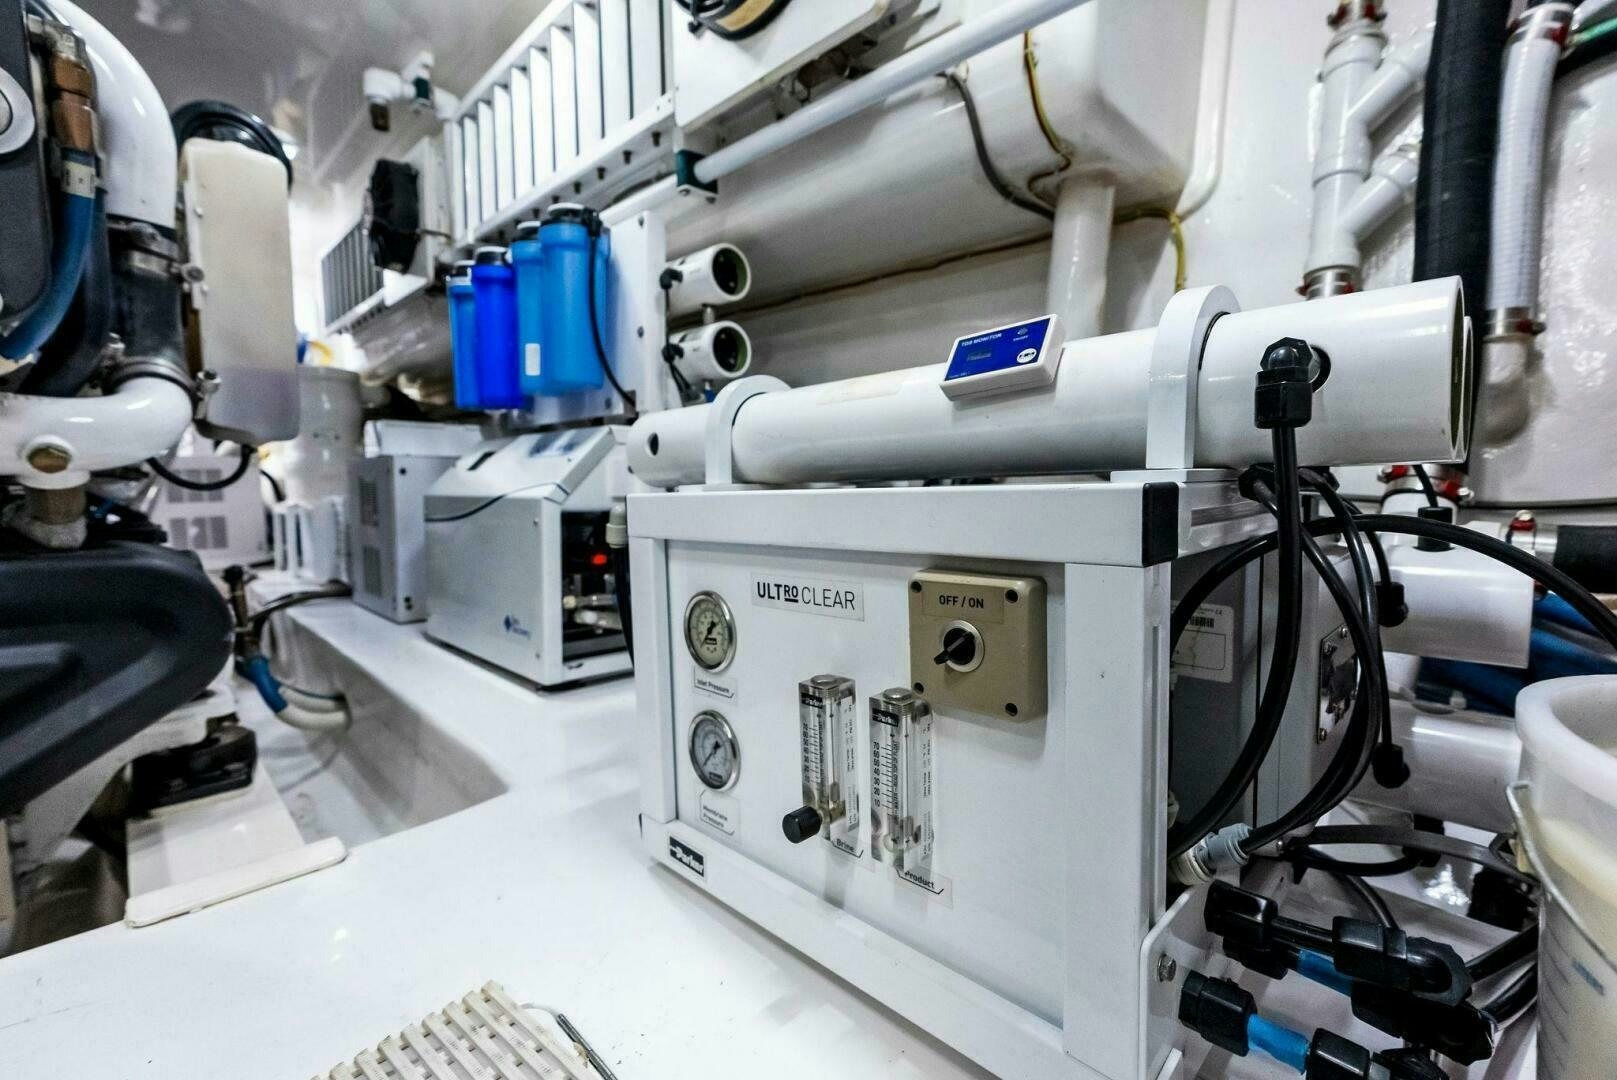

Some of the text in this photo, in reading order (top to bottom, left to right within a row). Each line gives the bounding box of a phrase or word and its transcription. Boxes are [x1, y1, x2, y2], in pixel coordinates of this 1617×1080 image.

[802, 587, 855, 610] CLEAR
[939, 595, 958, 605] OFF
[968, 597, 984, 608] ON
[836, 838, 855, 852] Brine
[905, 870, 934, 889] Product
